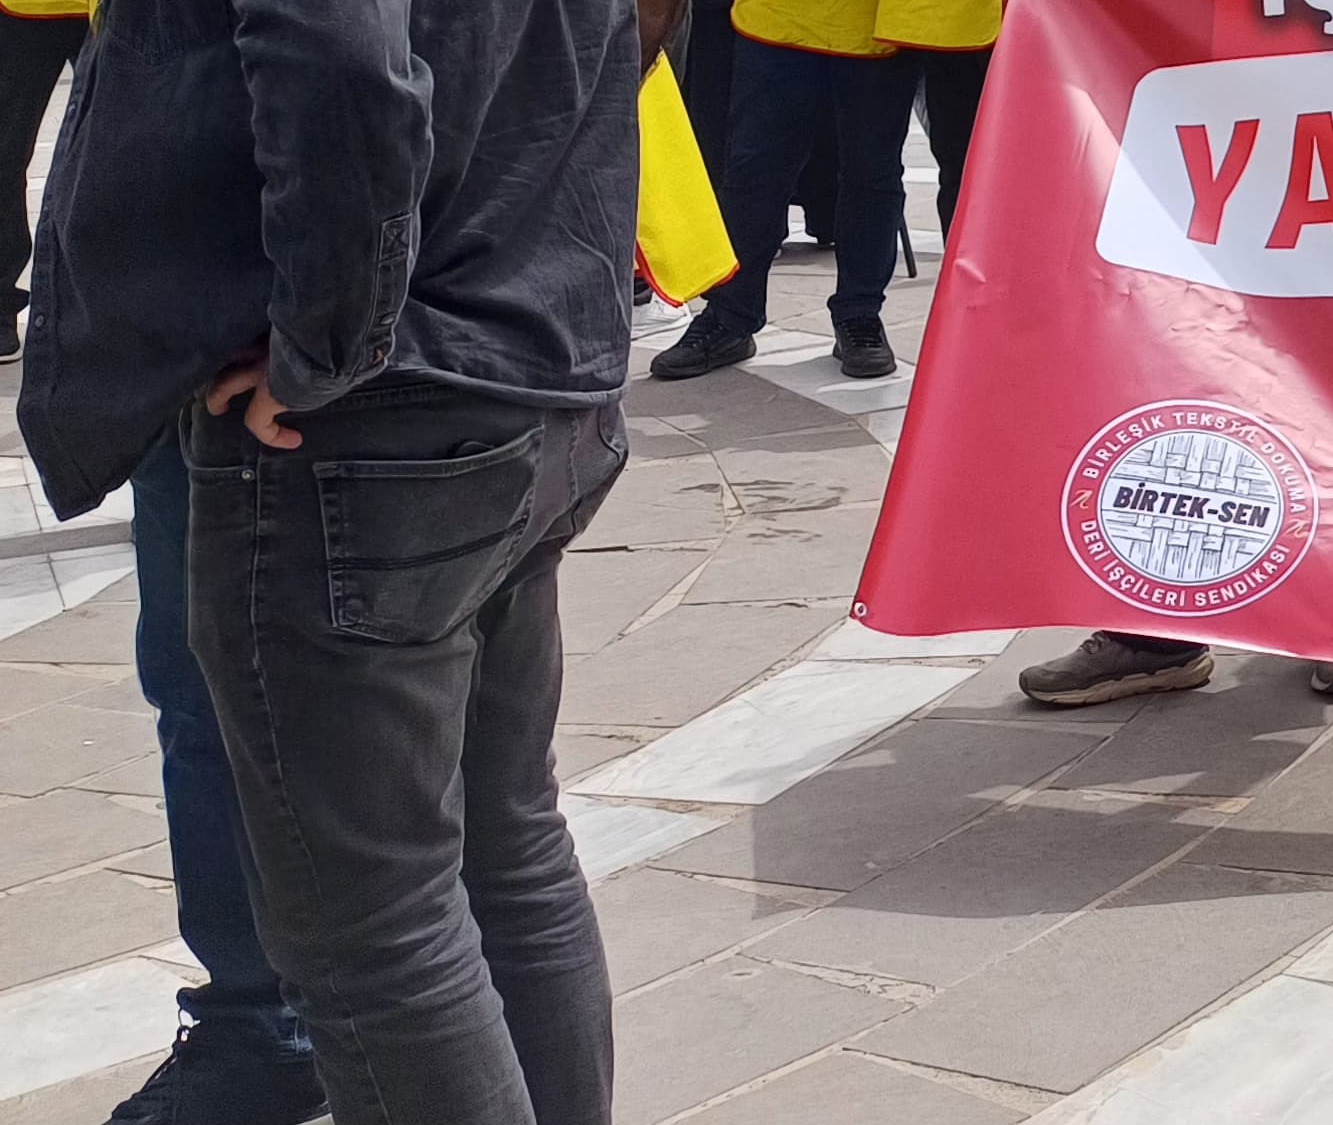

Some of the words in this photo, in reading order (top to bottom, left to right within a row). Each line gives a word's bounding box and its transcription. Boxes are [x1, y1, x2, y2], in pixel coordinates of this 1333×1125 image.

[1082, 414, 1165, 479] BİRLEŞİK
[1261, 441, 1307, 514] DOKUMA
[1112, 482, 1271, 528] BİRTEK-SEN
[1194, 544, 1290, 607] SENDİKASI
